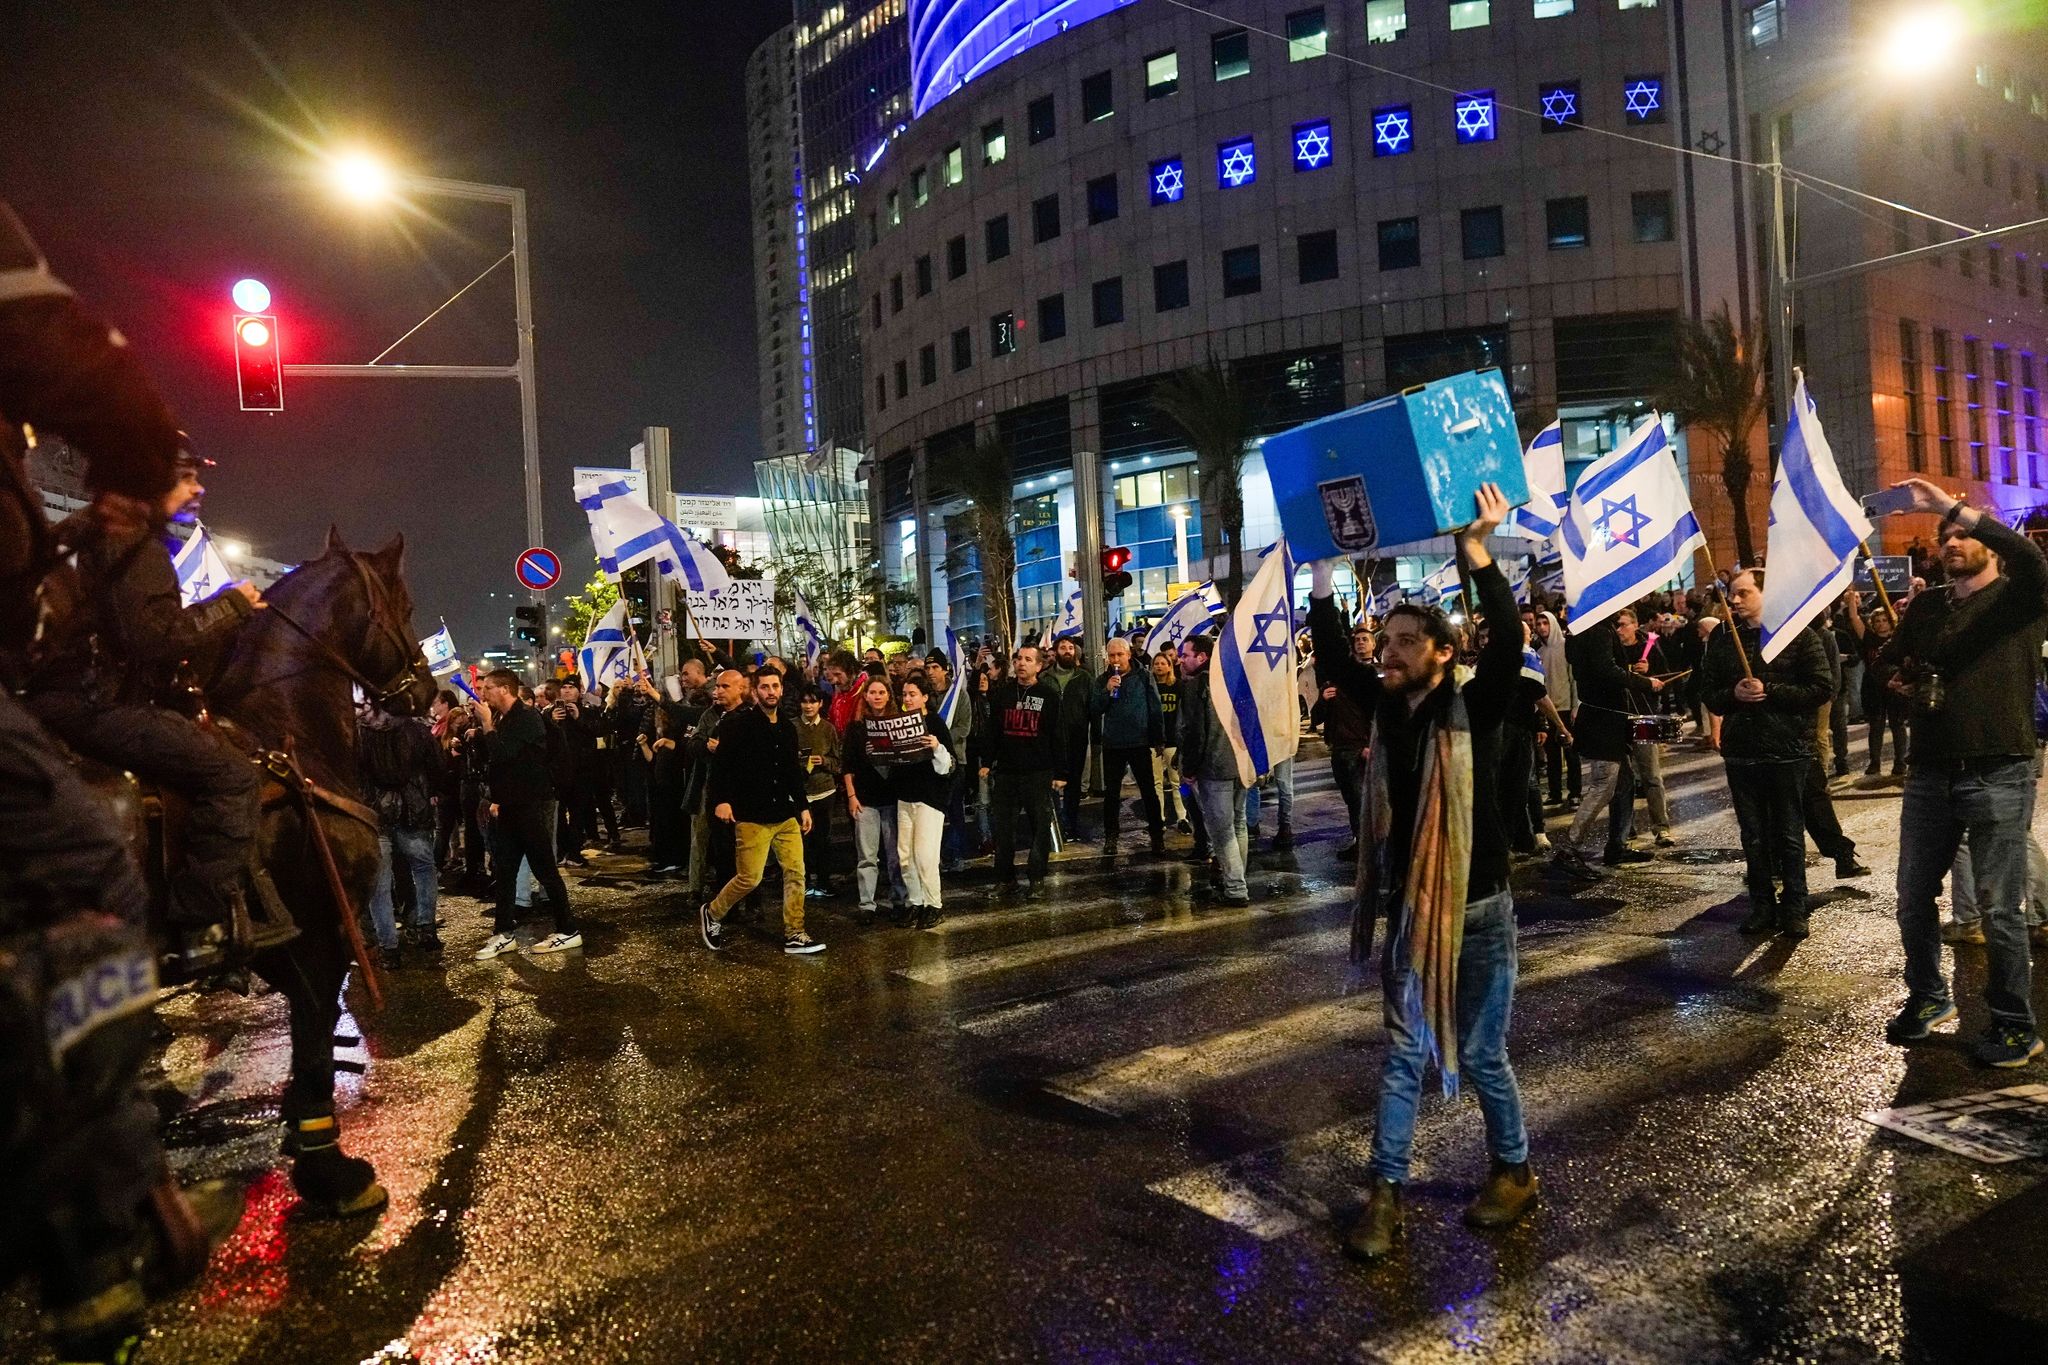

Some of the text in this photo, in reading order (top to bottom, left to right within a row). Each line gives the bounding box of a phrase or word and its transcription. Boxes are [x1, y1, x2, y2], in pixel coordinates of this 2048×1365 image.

[680, 499, 696, 507] קפלן
[878, 713, 922, 731] הפסקת
[889, 725, 925, 741] עכשיו
